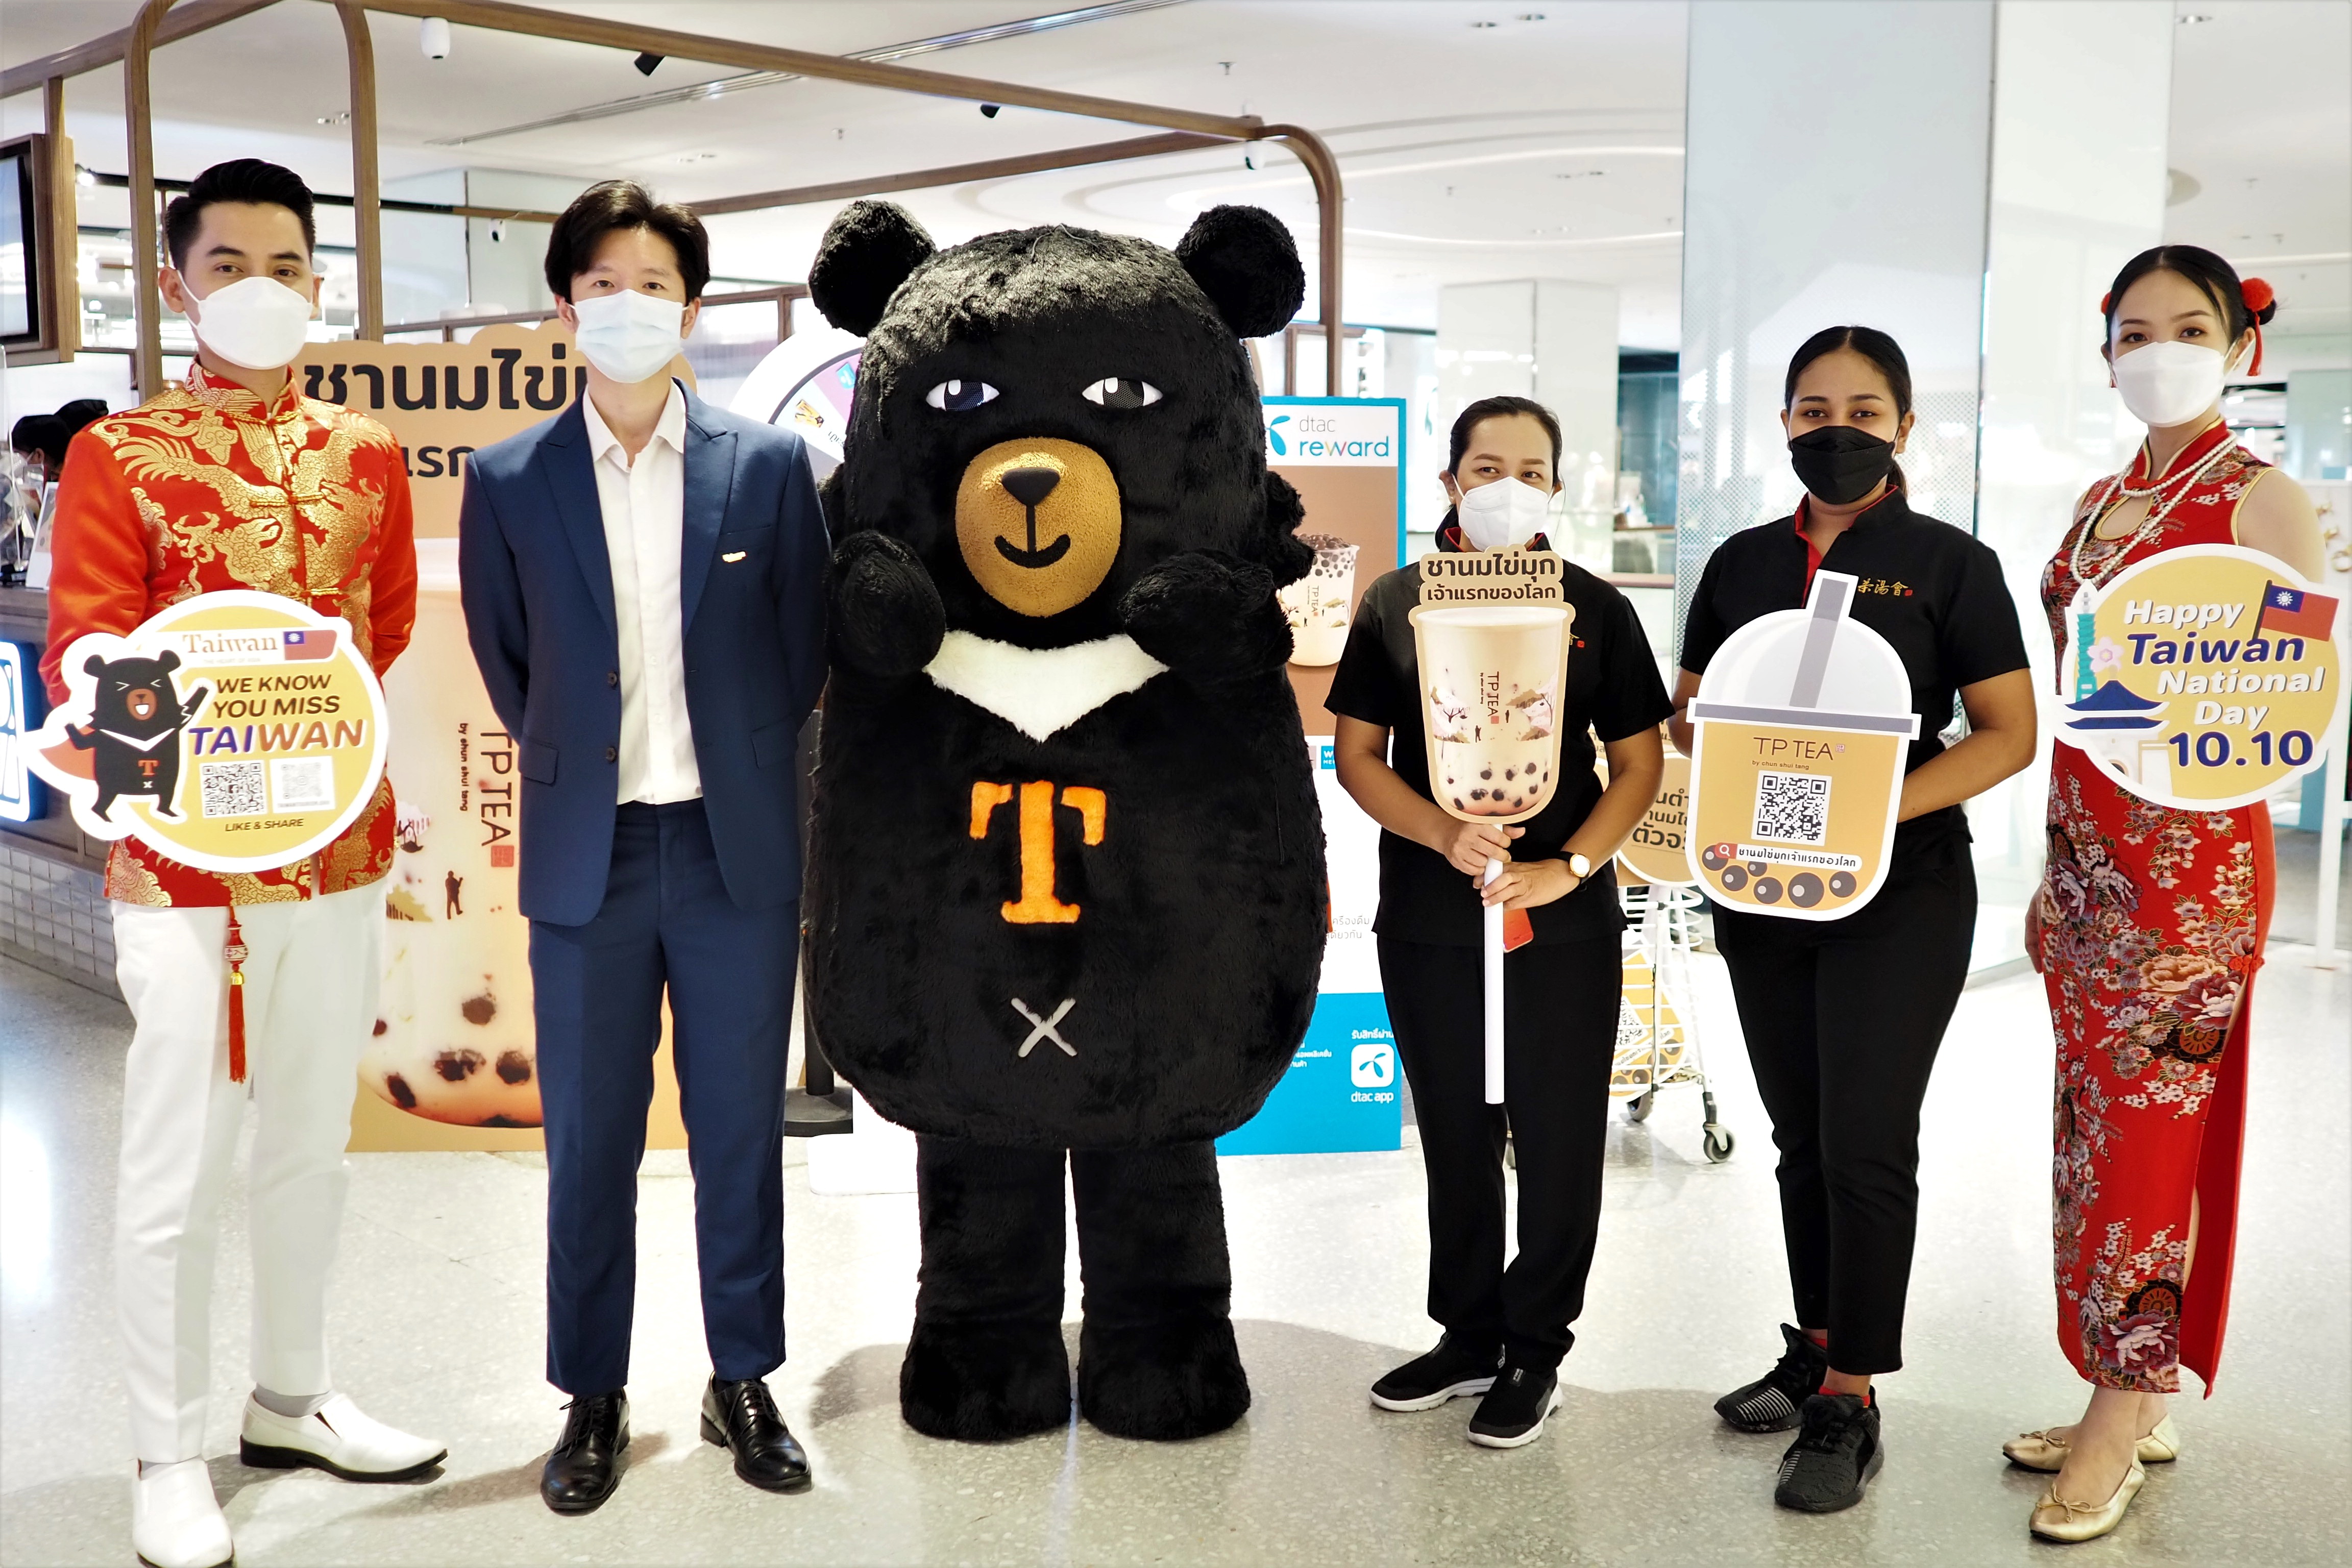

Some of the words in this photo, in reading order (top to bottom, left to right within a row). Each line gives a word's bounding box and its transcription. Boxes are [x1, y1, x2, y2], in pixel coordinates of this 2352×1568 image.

[305, 343, 587, 410] ชานมไข่
[1300, 415, 1335, 432] dtac
[1300, 435, 1389, 456] reward
[1428, 551, 1555, 582] ชานมไข่มุก
[1312, 585, 1319, 597] TP
[1428, 583, 1556, 600] เจ้าแรกของโลก
[2123, 600, 2245, 630] Happy
[183, 633, 278, 653] Taiwan
[2127, 631, 2305, 664] Taiwan
[217, 677, 253, 693] WE
[258, 674, 331, 692] KNOW
[1487, 671, 1499, 691] TP
[2158, 666, 2325, 694] National
[213, 699, 266, 718] YOU
[274, 696, 340, 715] MISS
[1487, 693, 1499, 717] TEA
[2194, 700, 2269, 730] Day
[188, 719, 364, 755] TAIWAN
[458, 723, 469, 734] by
[480, 731, 512, 775] TP
[1753, 737, 1788, 755] TP
[1793, 740, 1833, 761] TEA
[2169, 730, 2313, 767] 10.10
[138, 760, 159, 775] T
[459, 790, 469, 811] tang
[225, 821, 252, 832] LIKE
[253, 821, 261, 829] &
[263, 818, 304, 829] SHARE
[481, 782, 512, 846] TEA
[969, 780, 1107, 924] T
[1351, 1091, 1374, 1102] dtac
[1374, 1092, 1394, 1104] app
